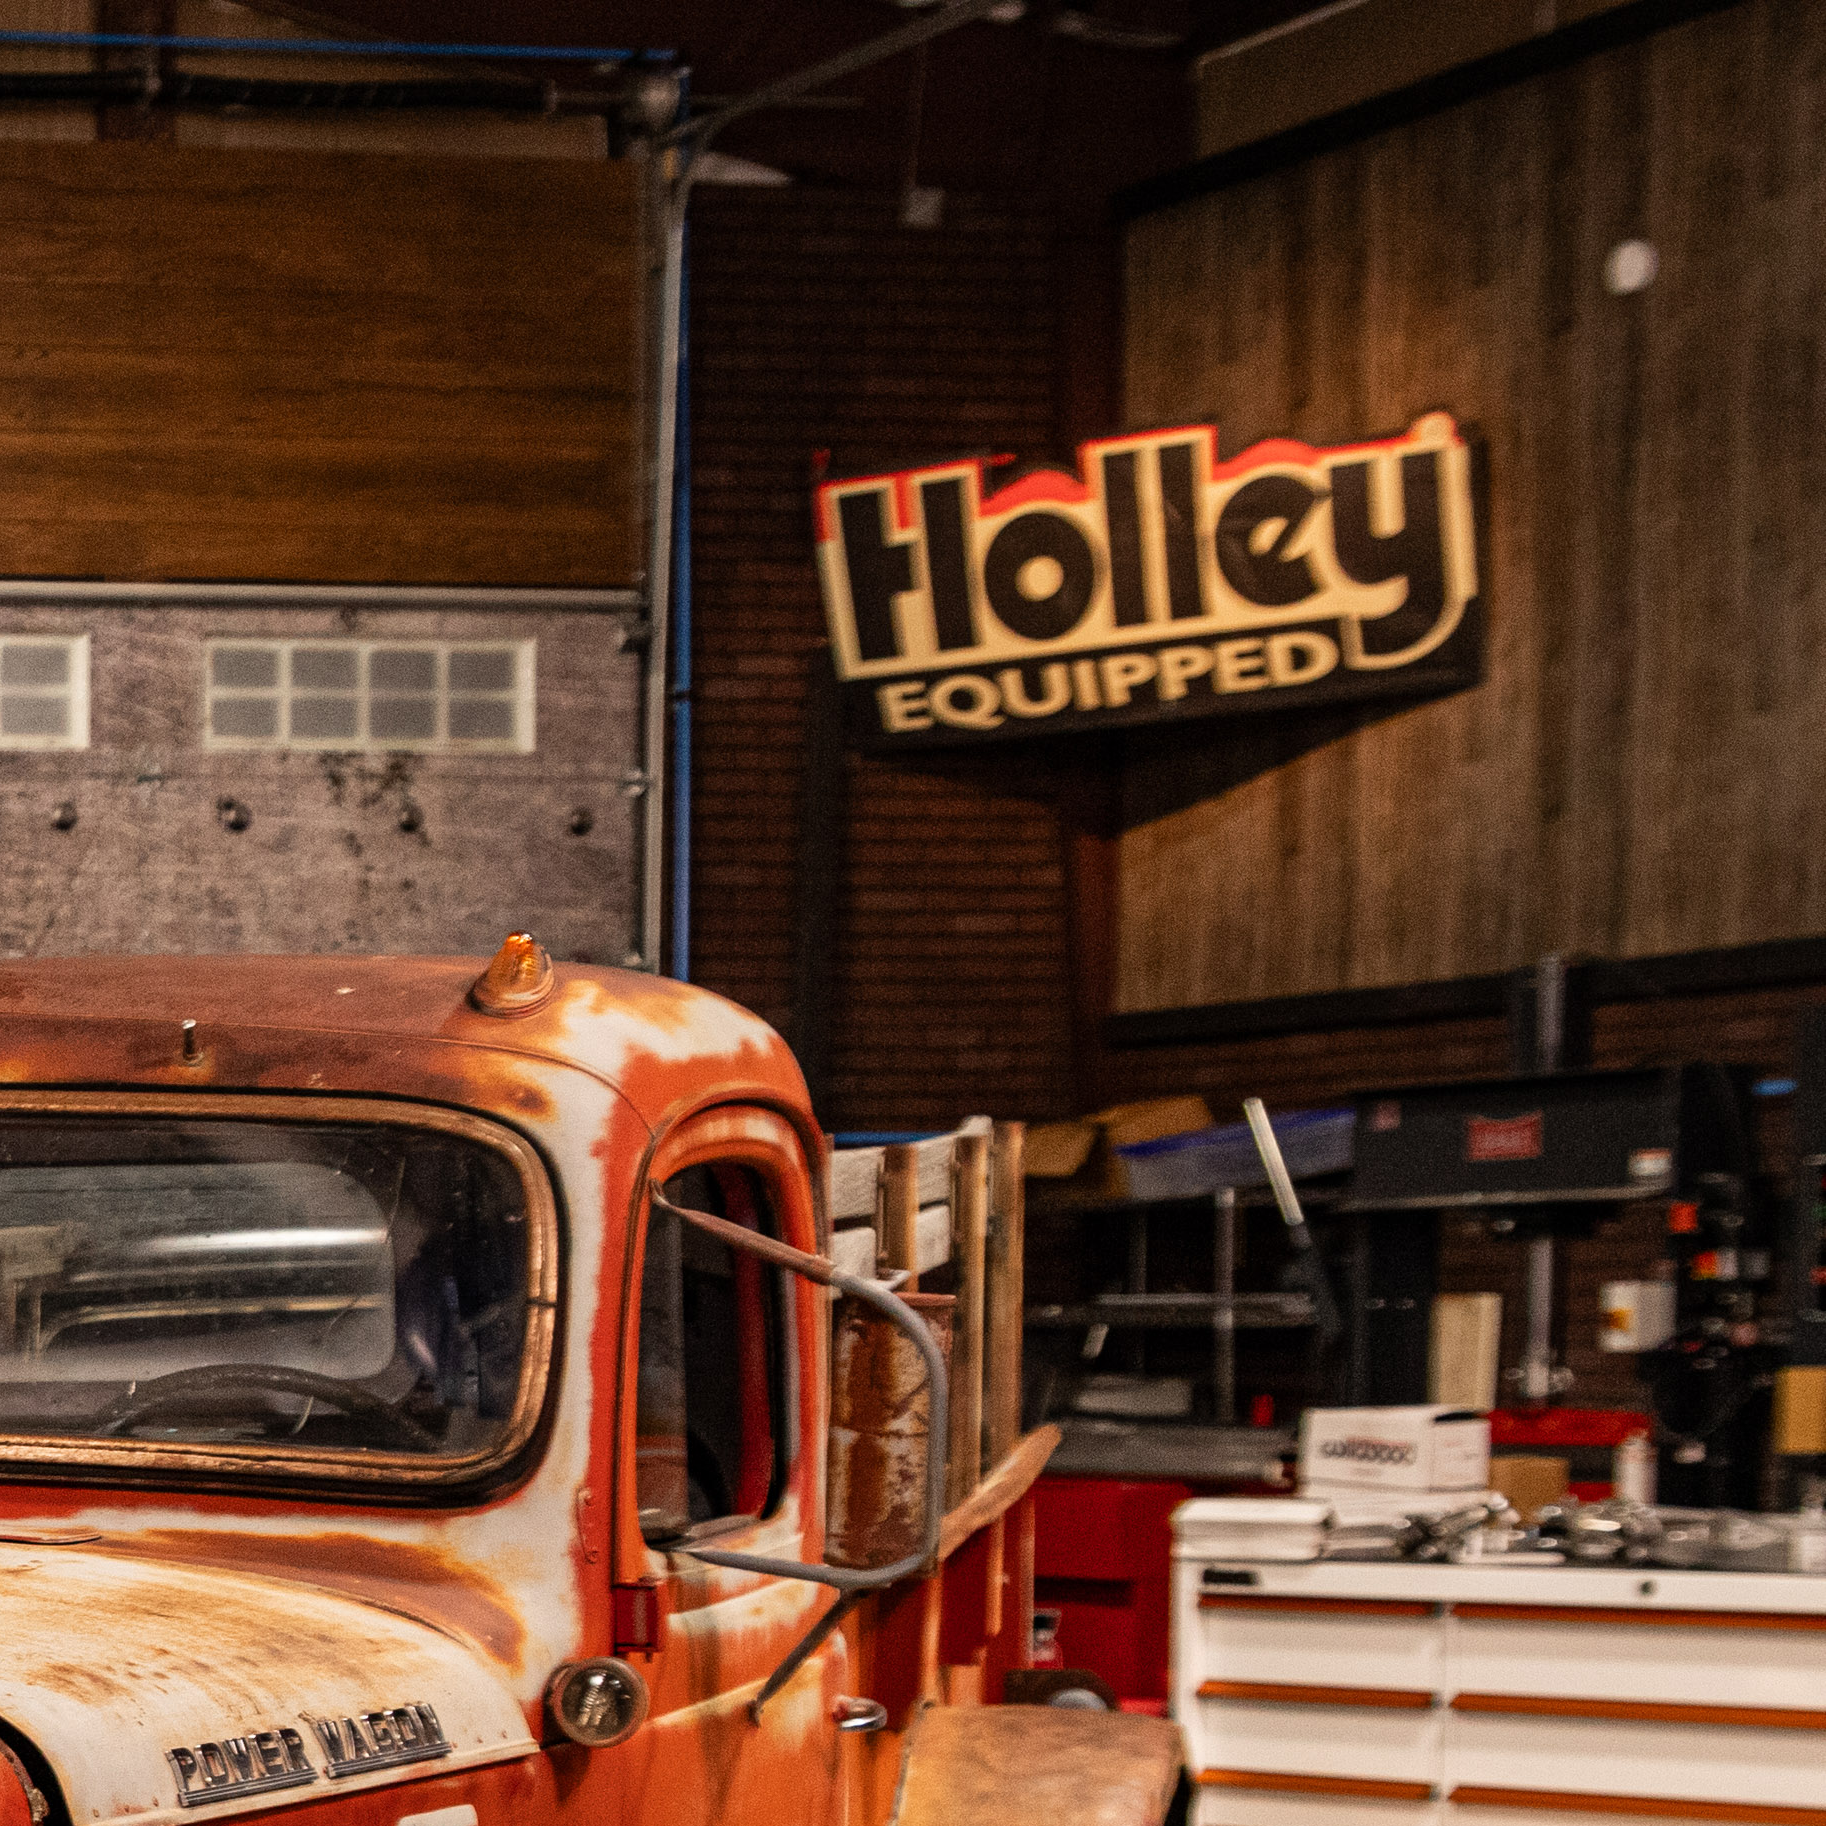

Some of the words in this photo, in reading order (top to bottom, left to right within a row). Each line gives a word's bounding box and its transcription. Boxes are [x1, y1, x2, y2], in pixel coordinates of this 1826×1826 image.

[819, 412, 1475, 680] Holley
[878, 630, 1341, 734] EQUIPPED
[164, 1728, 314, 1793] POWER
[309, 1703, 448, 1763] WAGON
